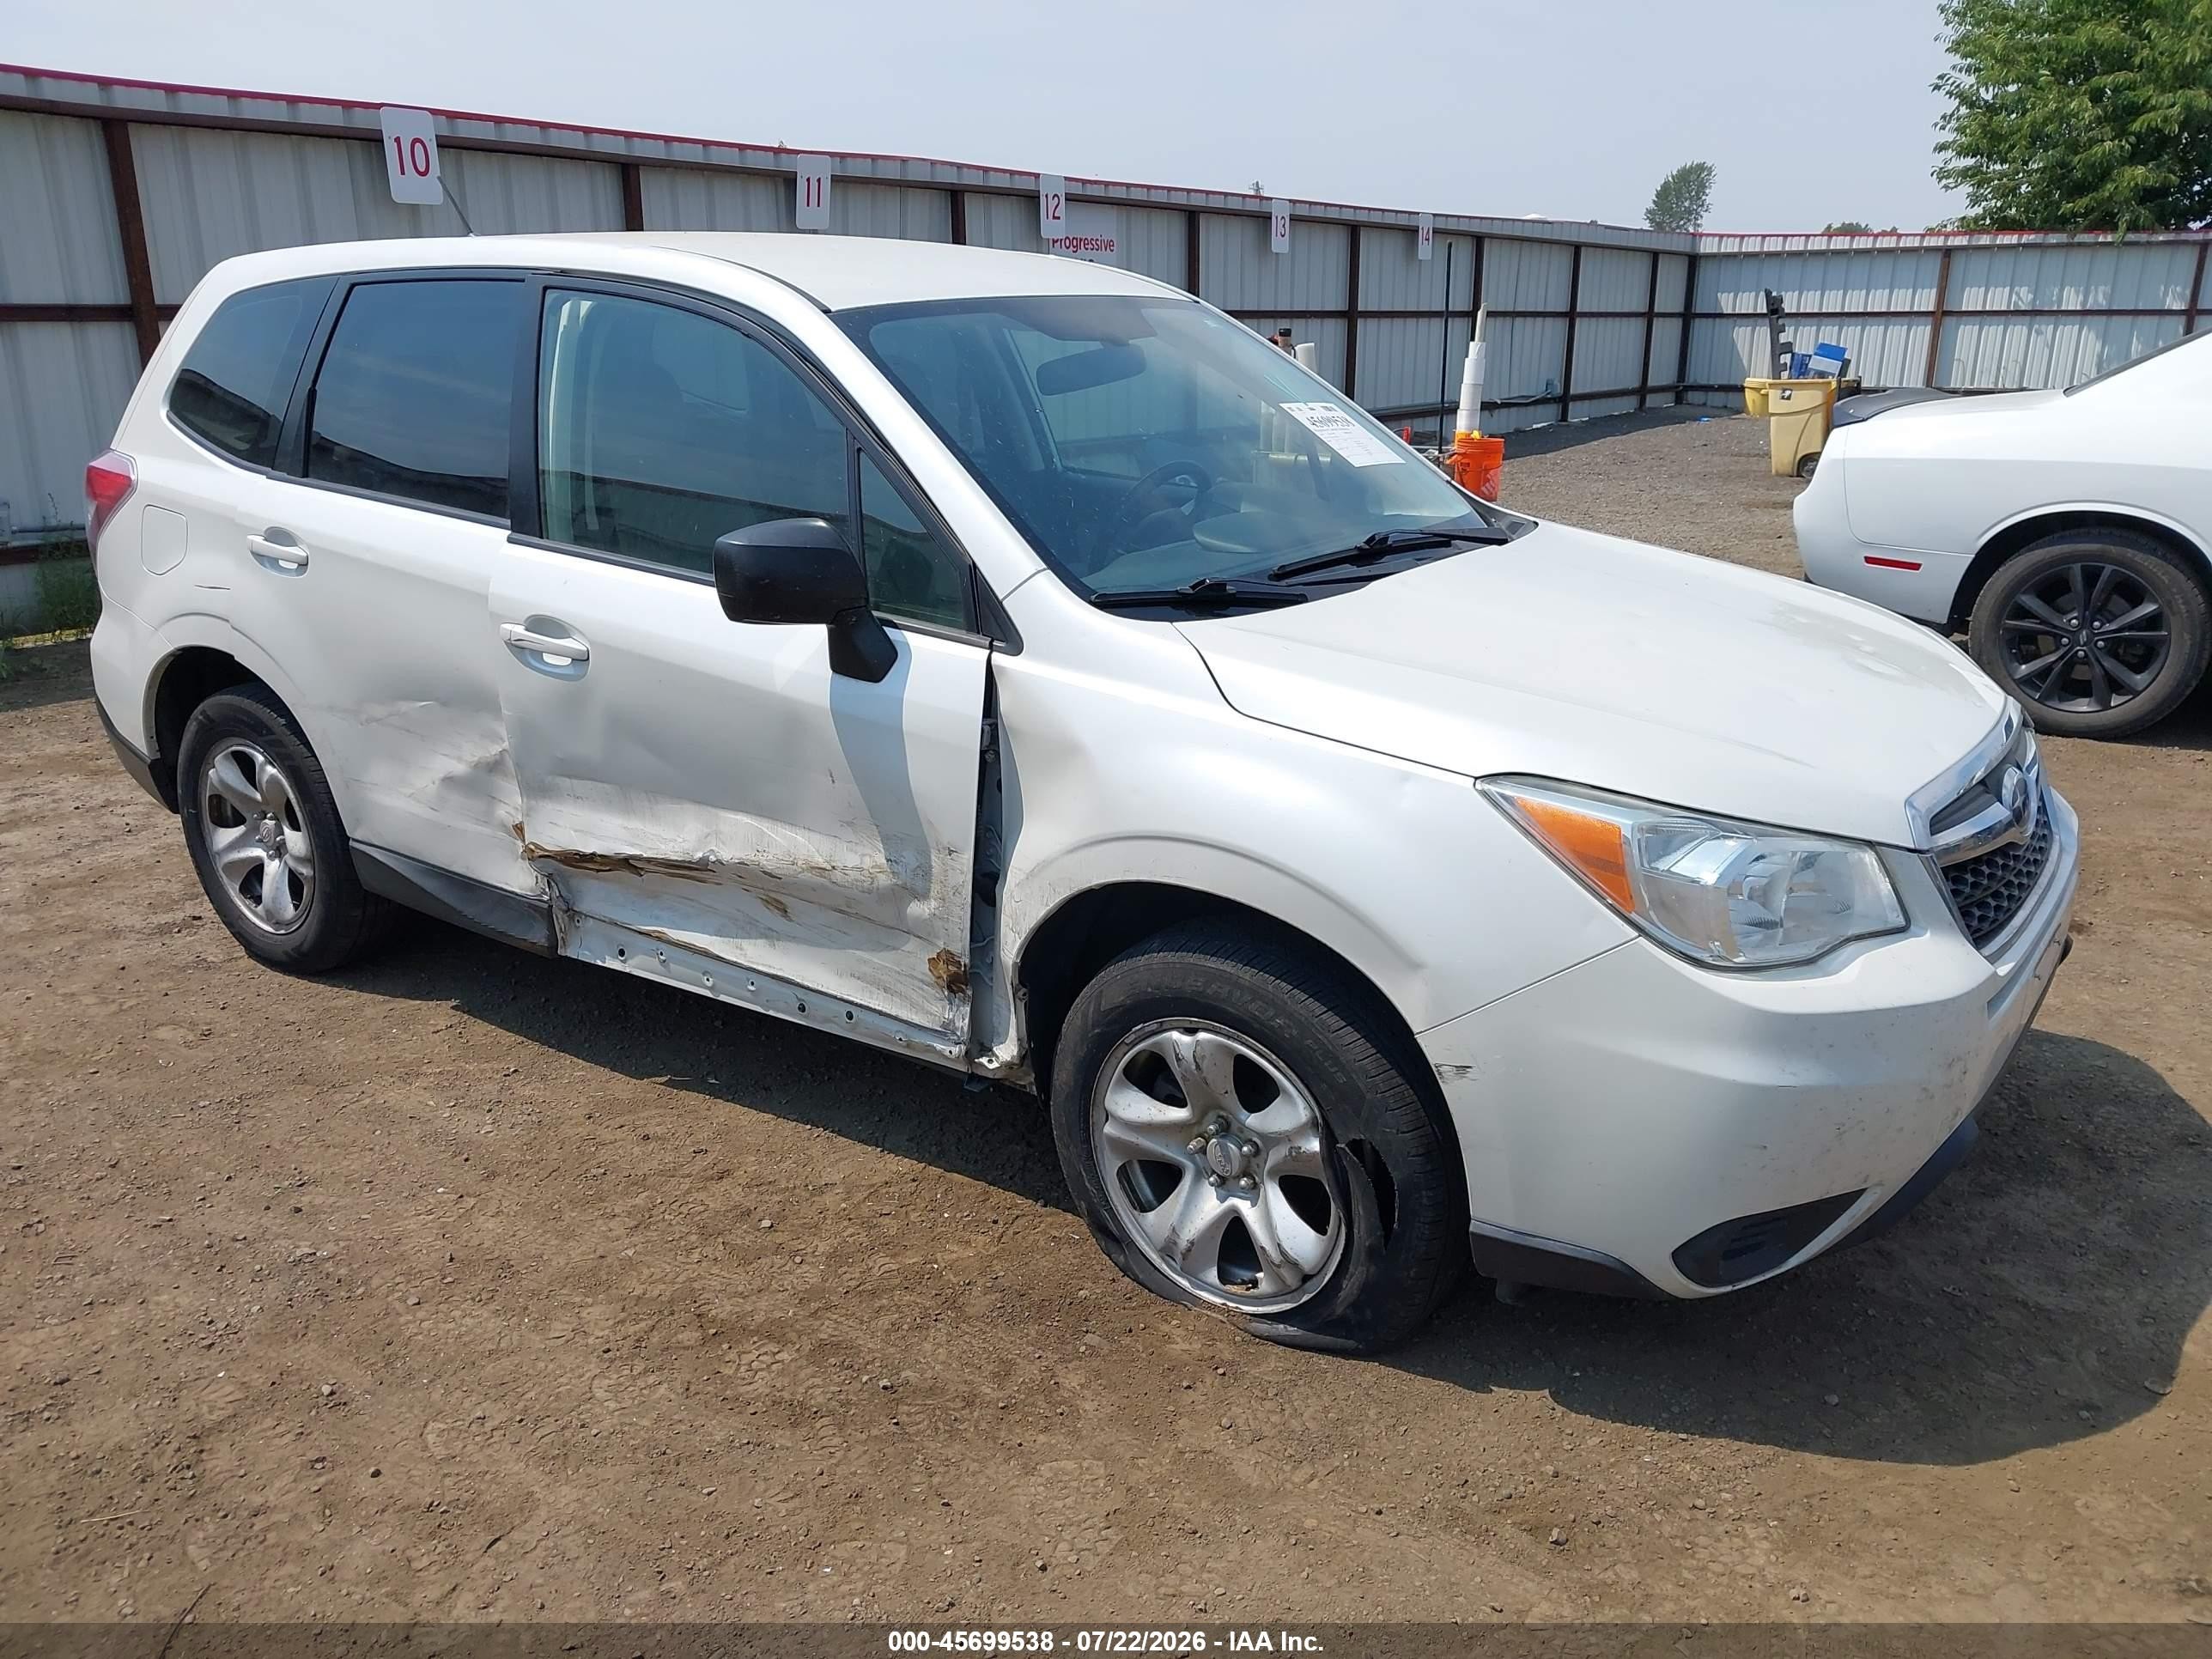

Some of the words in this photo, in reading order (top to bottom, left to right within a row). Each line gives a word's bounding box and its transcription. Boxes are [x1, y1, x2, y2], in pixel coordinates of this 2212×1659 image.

[394, 136, 430, 177] 10
[805, 176, 822, 208] 11
[1045, 193, 1061, 221] 12
[1275, 215, 1286, 238] 13
[1421, 226, 1430, 246] 14
